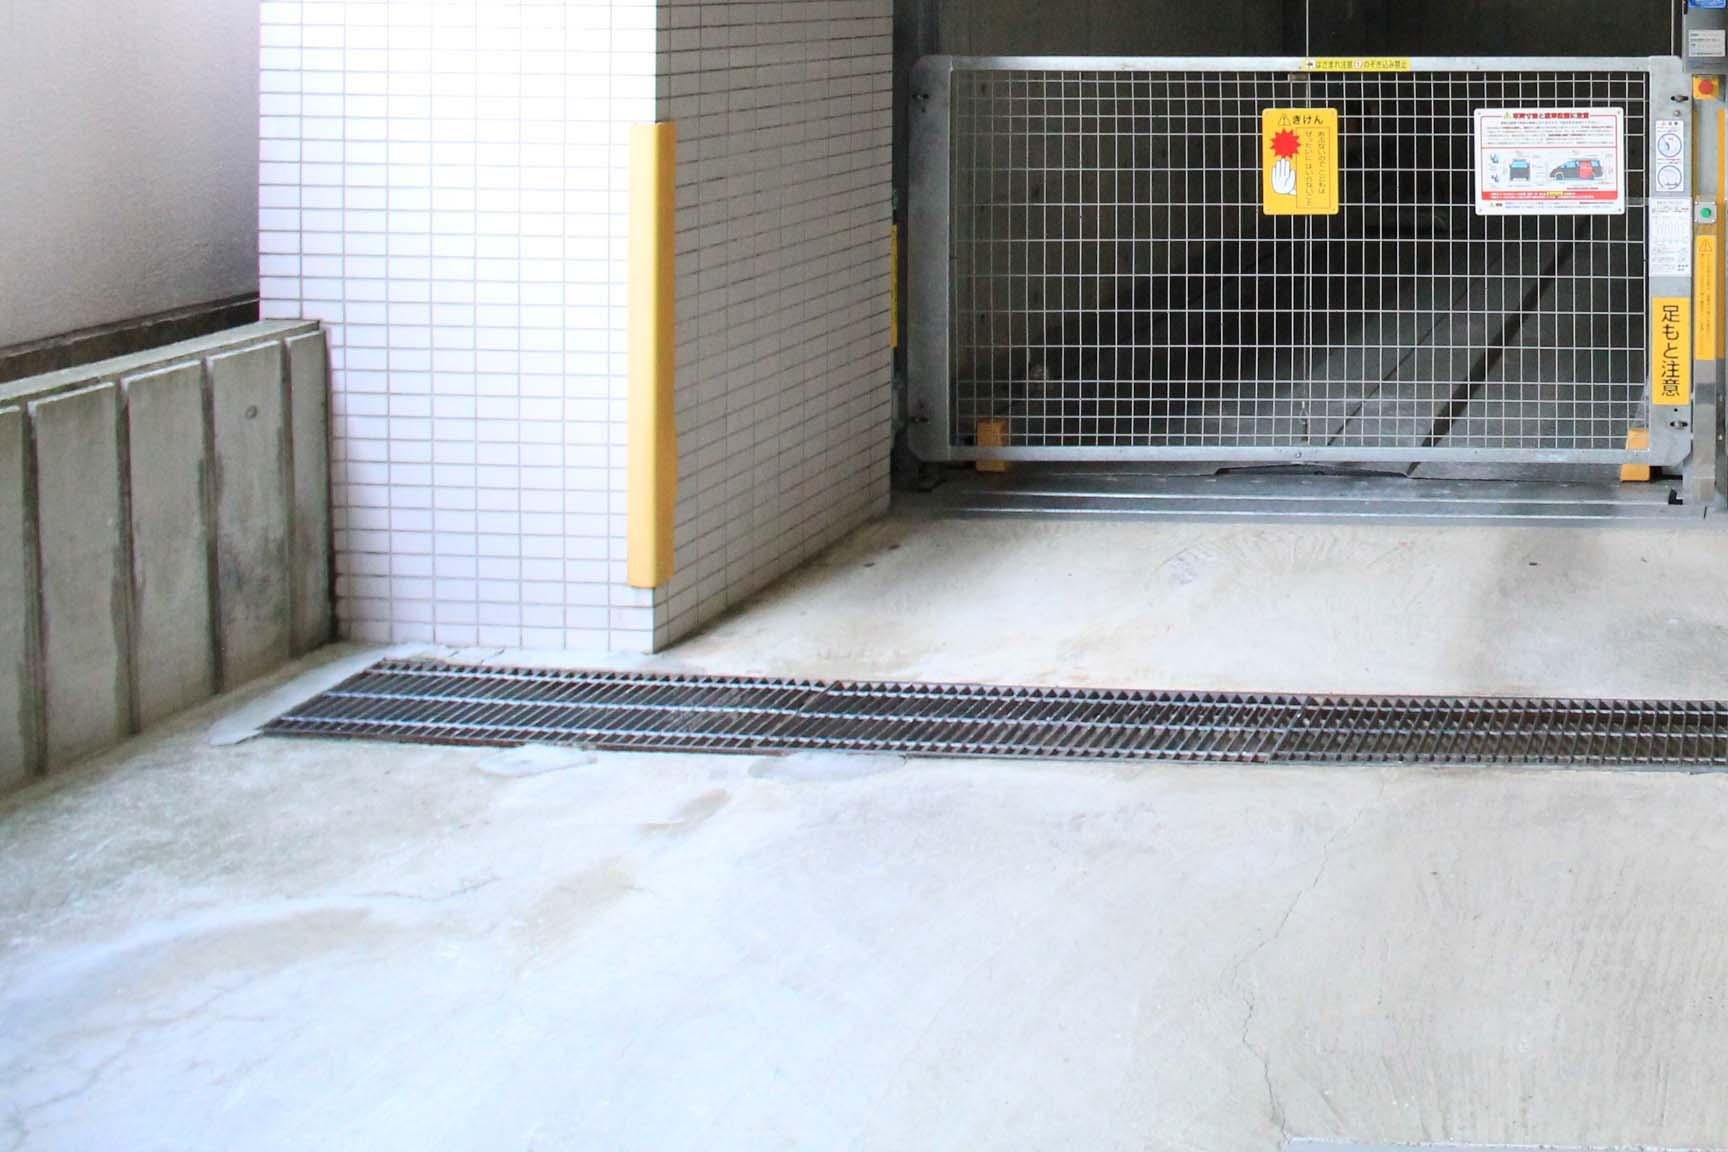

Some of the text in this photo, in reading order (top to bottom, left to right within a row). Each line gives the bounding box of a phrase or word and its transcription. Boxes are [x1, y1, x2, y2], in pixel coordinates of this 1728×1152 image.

[1292, 115, 1324, 125] きけん
[1661, 304, 1681, 397] 足もと注意
